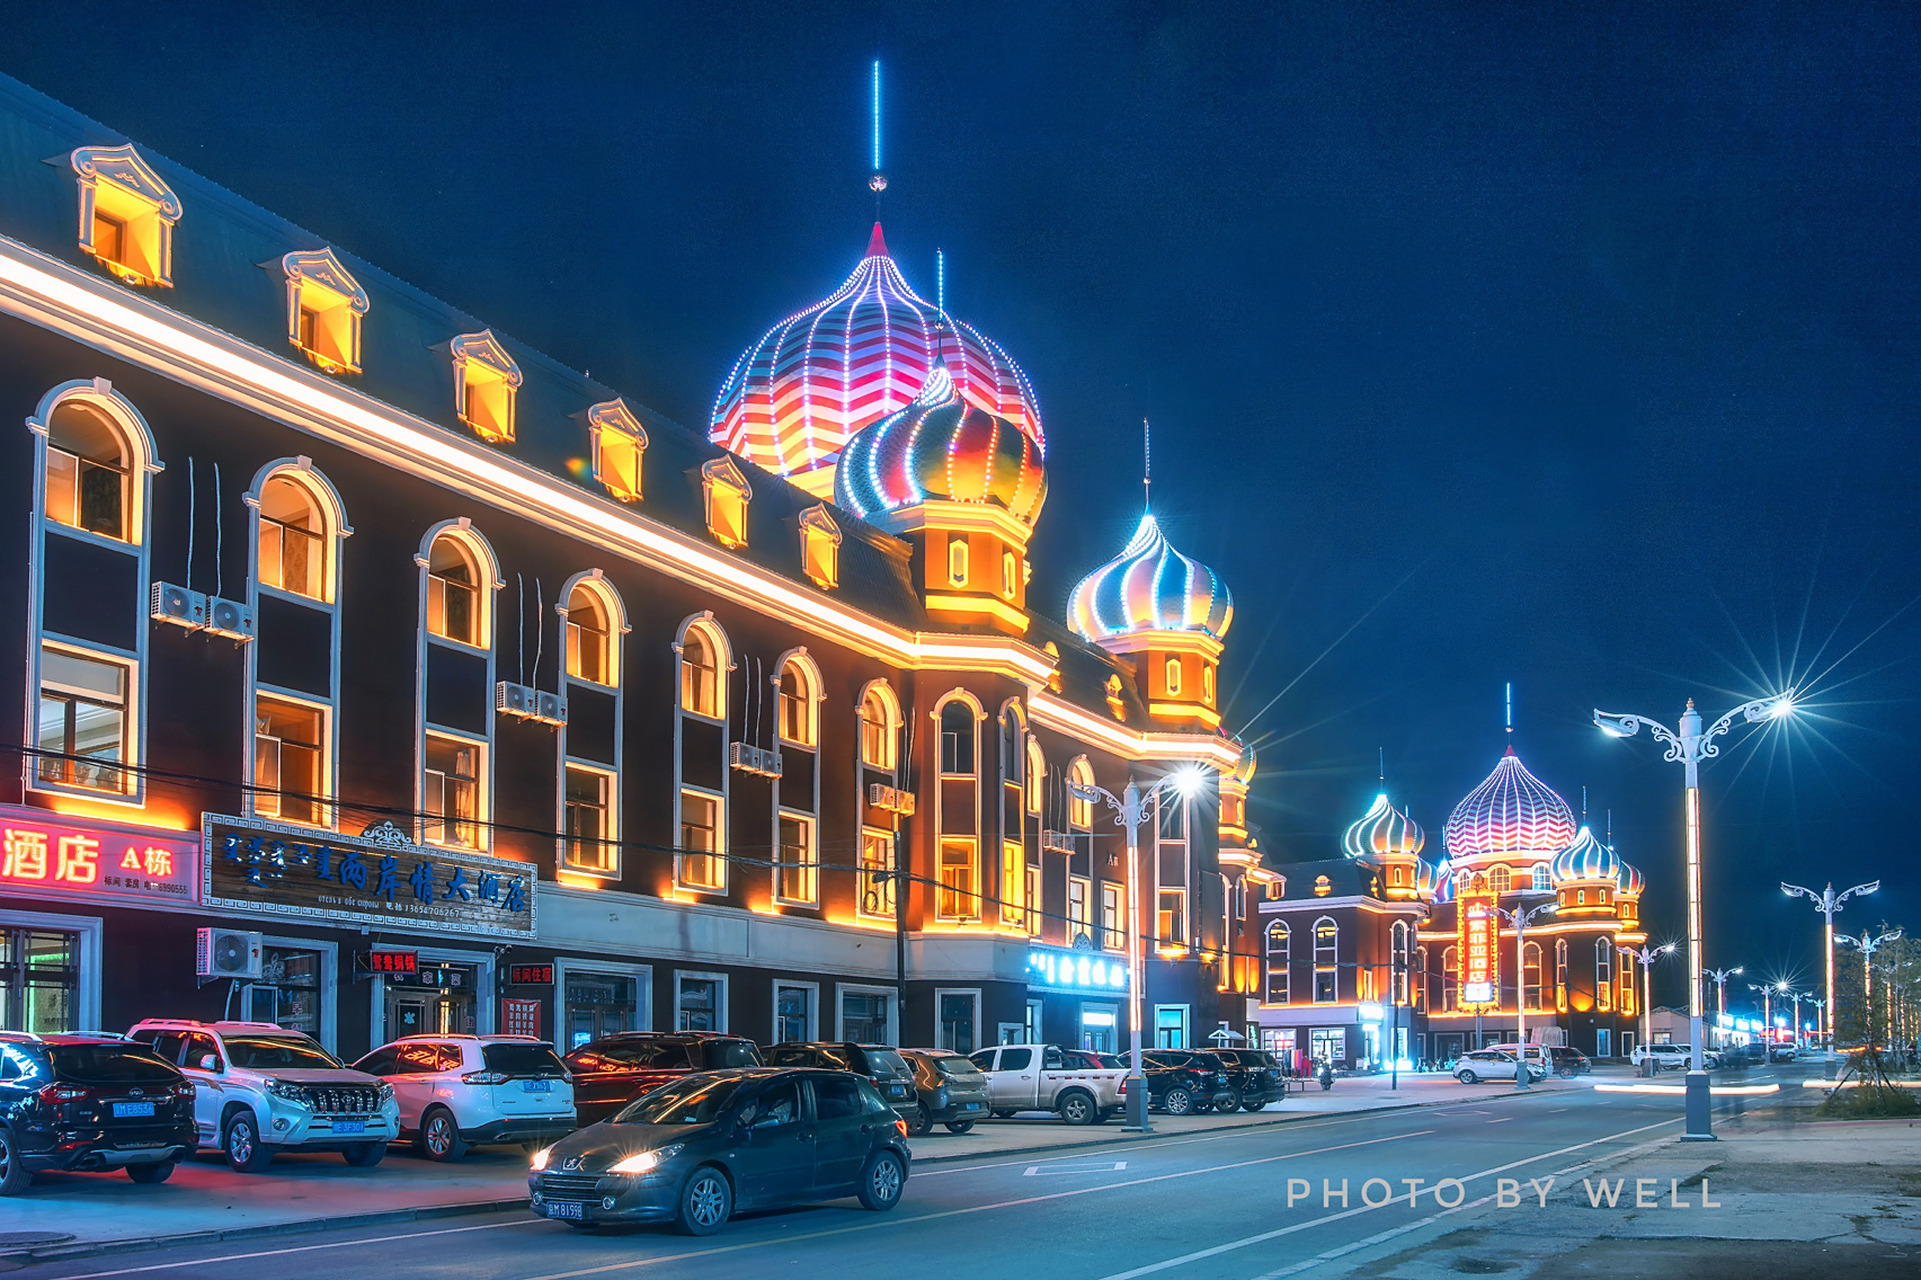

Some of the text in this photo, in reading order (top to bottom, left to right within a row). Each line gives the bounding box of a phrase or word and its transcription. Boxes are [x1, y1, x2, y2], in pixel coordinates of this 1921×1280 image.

[2, 828, 99, 884] 酒店
[120, 847, 173, 877] A栋
[338, 850, 526, 913] 两岸情大酒店
